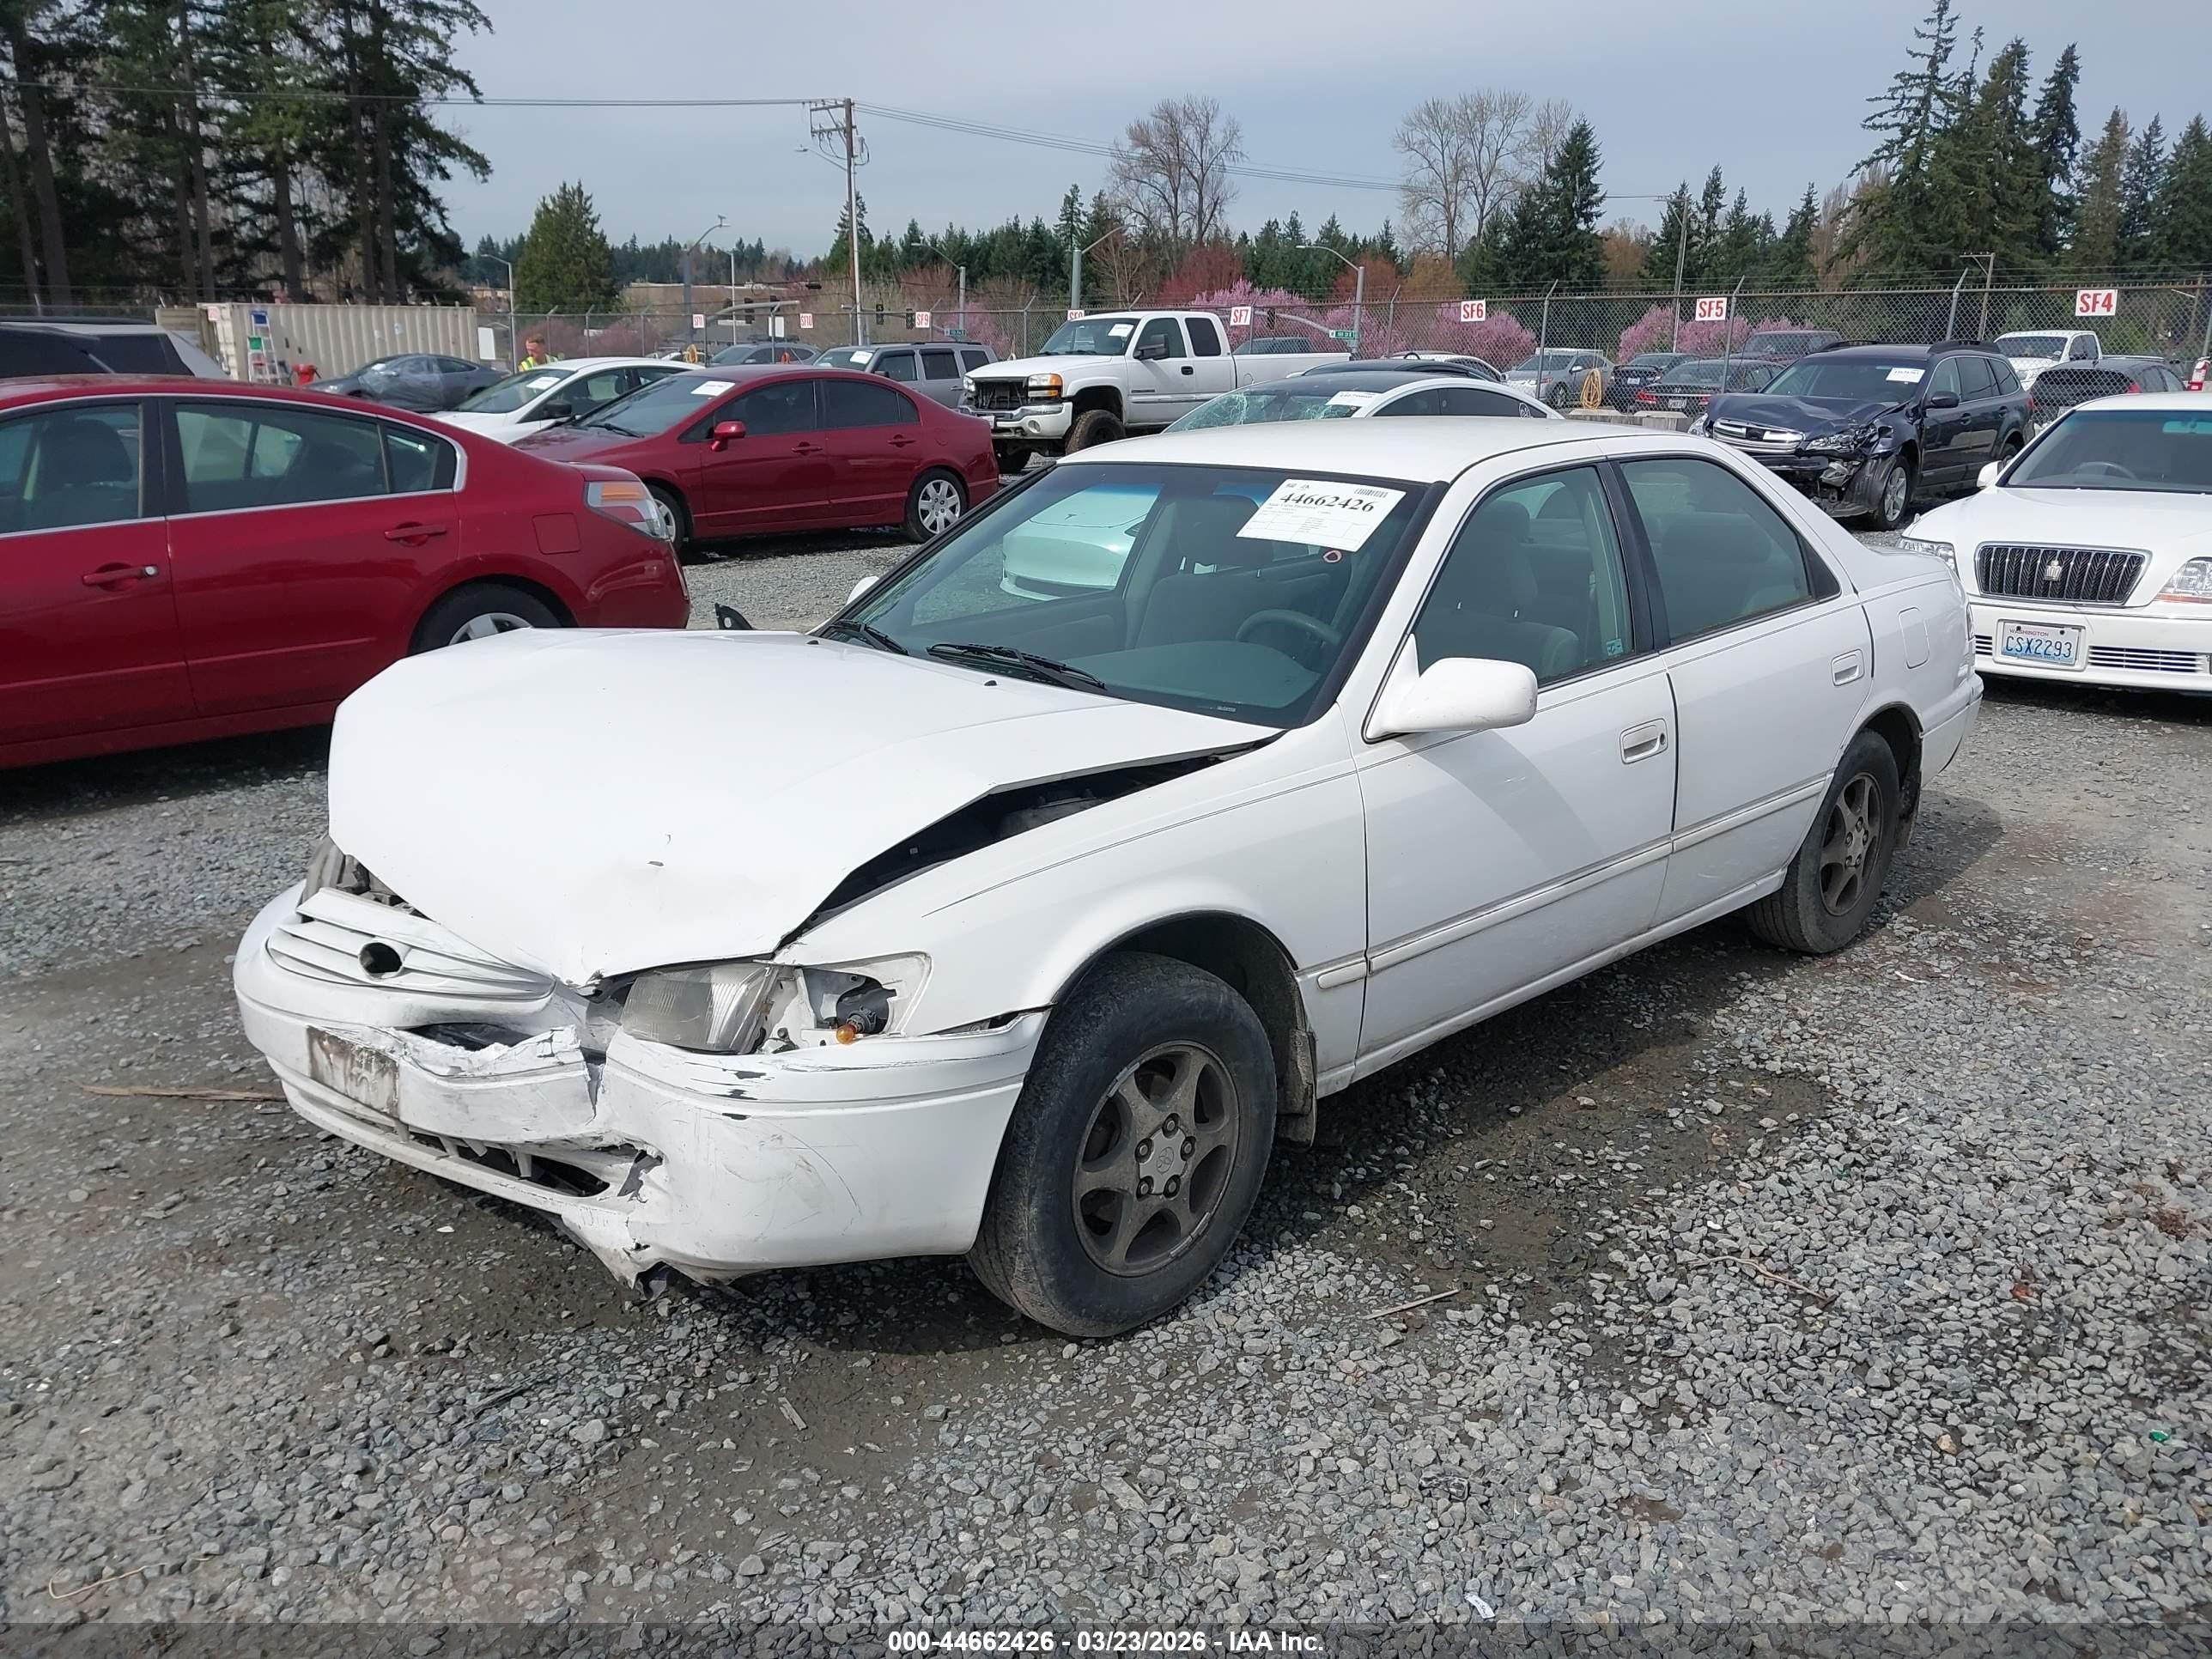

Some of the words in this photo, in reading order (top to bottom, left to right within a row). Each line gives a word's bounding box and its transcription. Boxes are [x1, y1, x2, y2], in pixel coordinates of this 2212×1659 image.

[1462, 302, 1484, 319] SF6
[1698, 300, 1723, 318] SF5
[2079, 292, 2113, 313] SF4
[800, 315, 812, 326] SF10
[916, 313, 928, 325] SF9
[1232, 308, 1249, 324] SF7
[1279, 492, 1376, 513] 44662426
[2009, 629, 2049, 637] WASHINGTON
[2005, 635, 2072, 658] CSX2293
